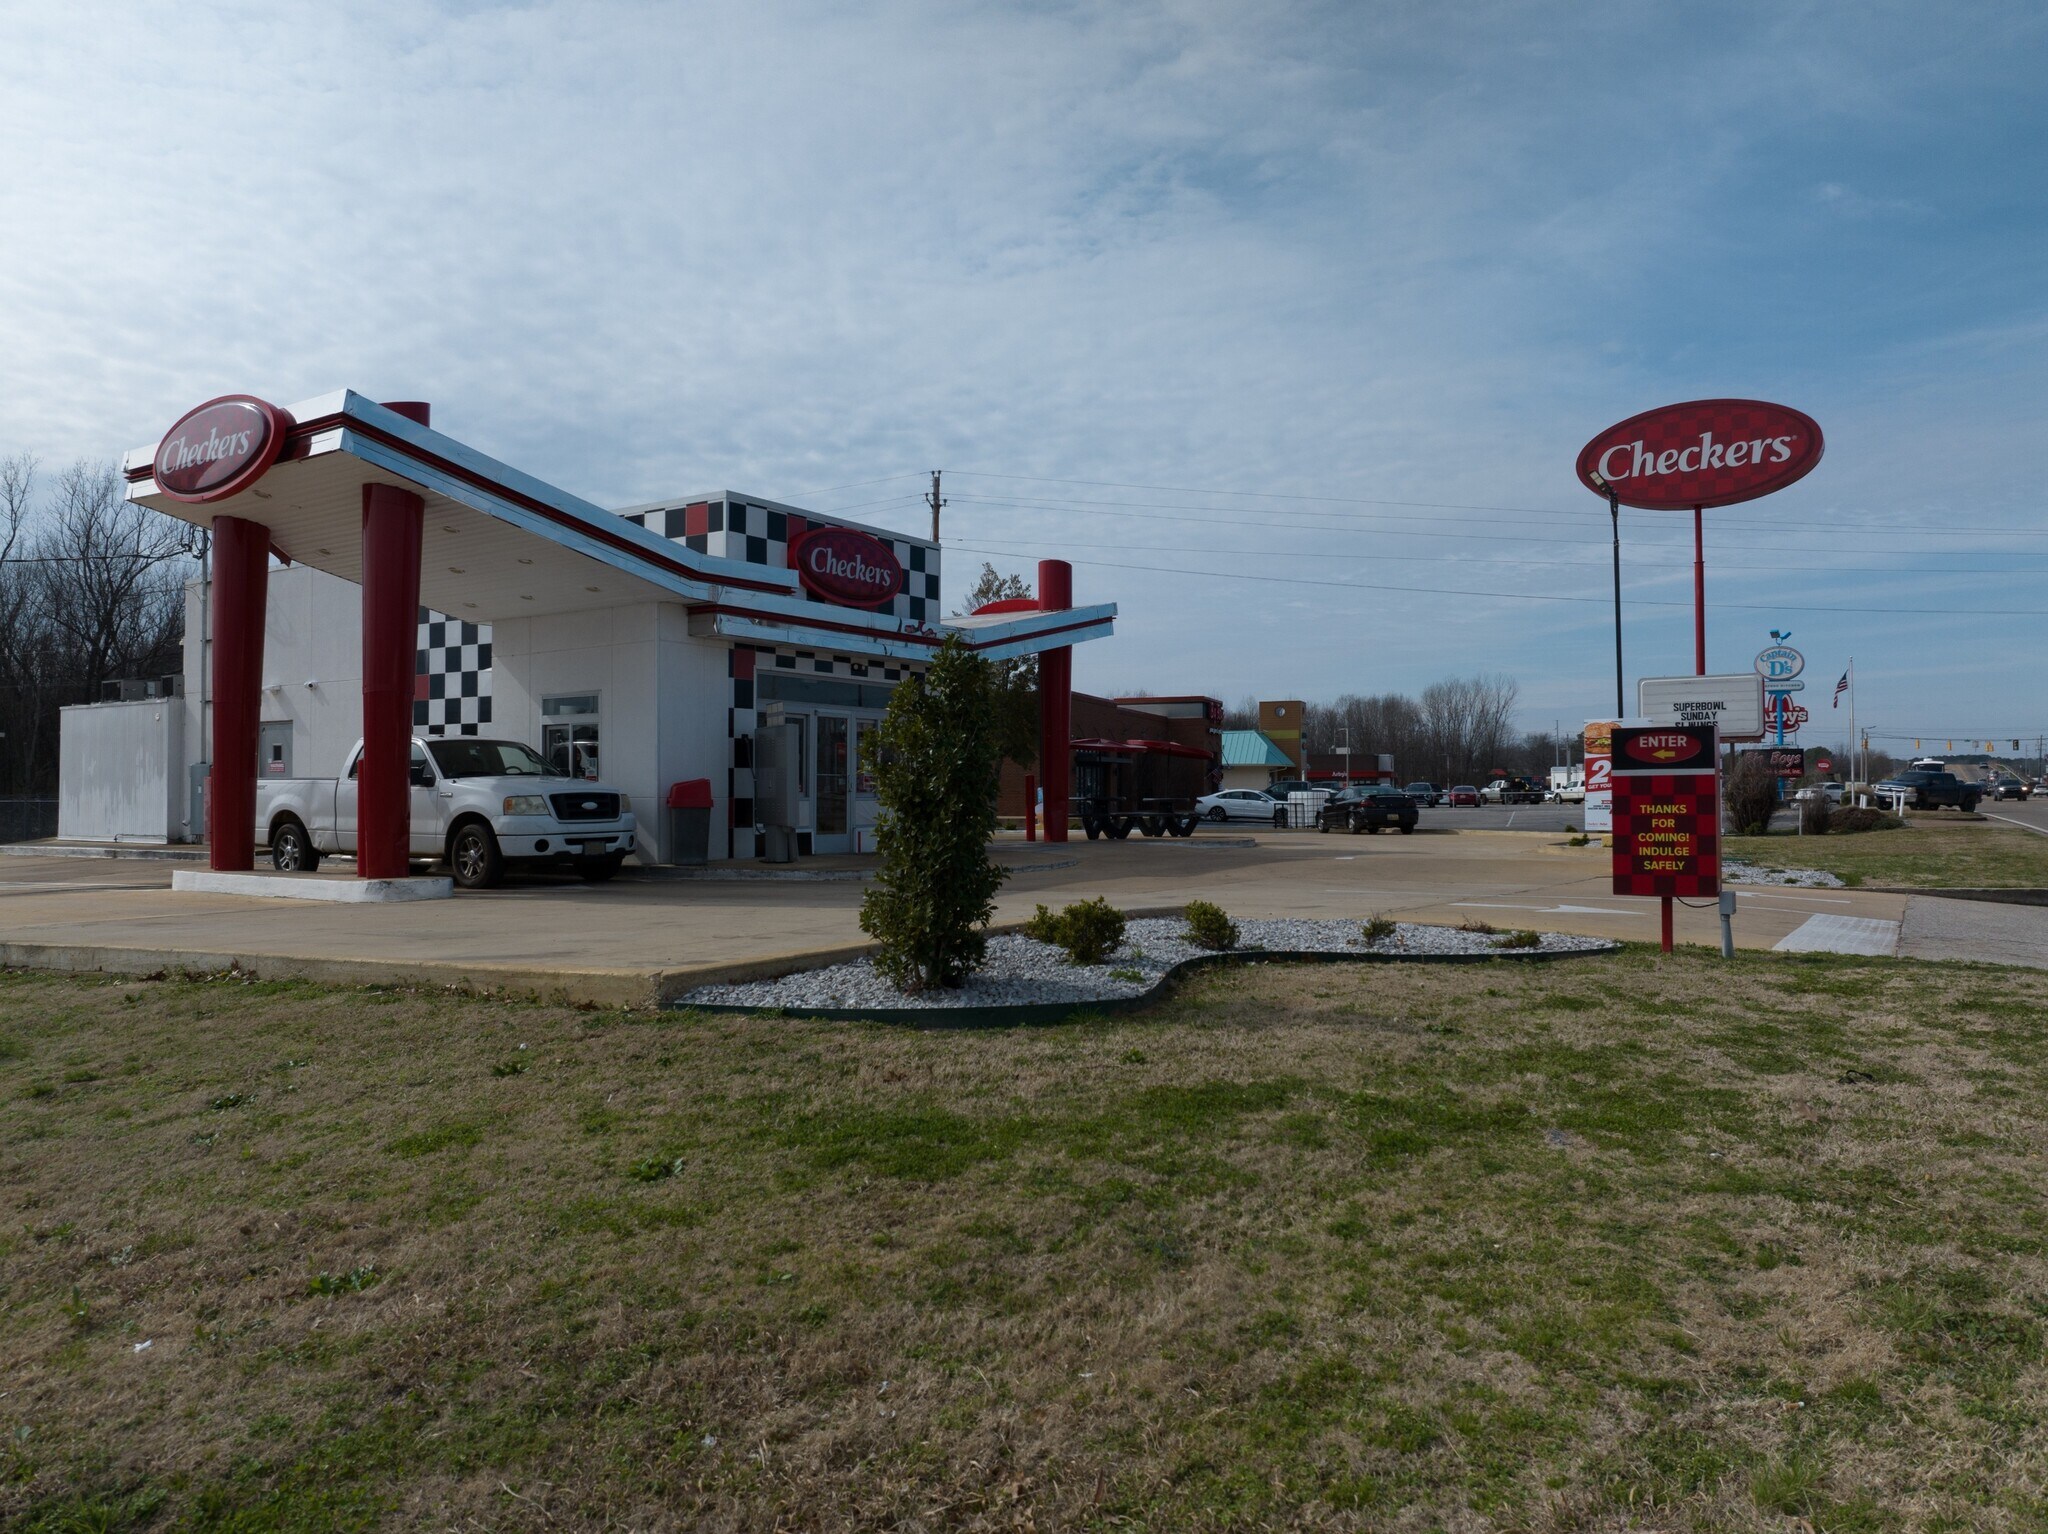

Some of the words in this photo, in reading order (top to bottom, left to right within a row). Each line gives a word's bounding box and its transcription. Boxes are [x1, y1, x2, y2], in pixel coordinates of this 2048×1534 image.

[161, 426, 252, 475] Checkers
[1597, 431, 1793, 482] Checkers
[810, 546, 892, 587] Checkers
[1760, 650, 1797, 662] Captain
[1769, 660, 1793, 676] D's
[1673, 701, 1727, 712] SUPERBOWL
[1681, 711, 1717, 721] SUNDAY
[1639, 735, 1688, 748] ENTER
[1770, 751, 1802, 768] Boys
[1640, 804, 1687, 814] THANKS
[1651, 818, 1675, 828] FOR
[1638, 832, 1690, 842] COMING!
[1639, 846, 1690, 856] INDULGE
[1643, 860, 1685, 871] SAFELY
